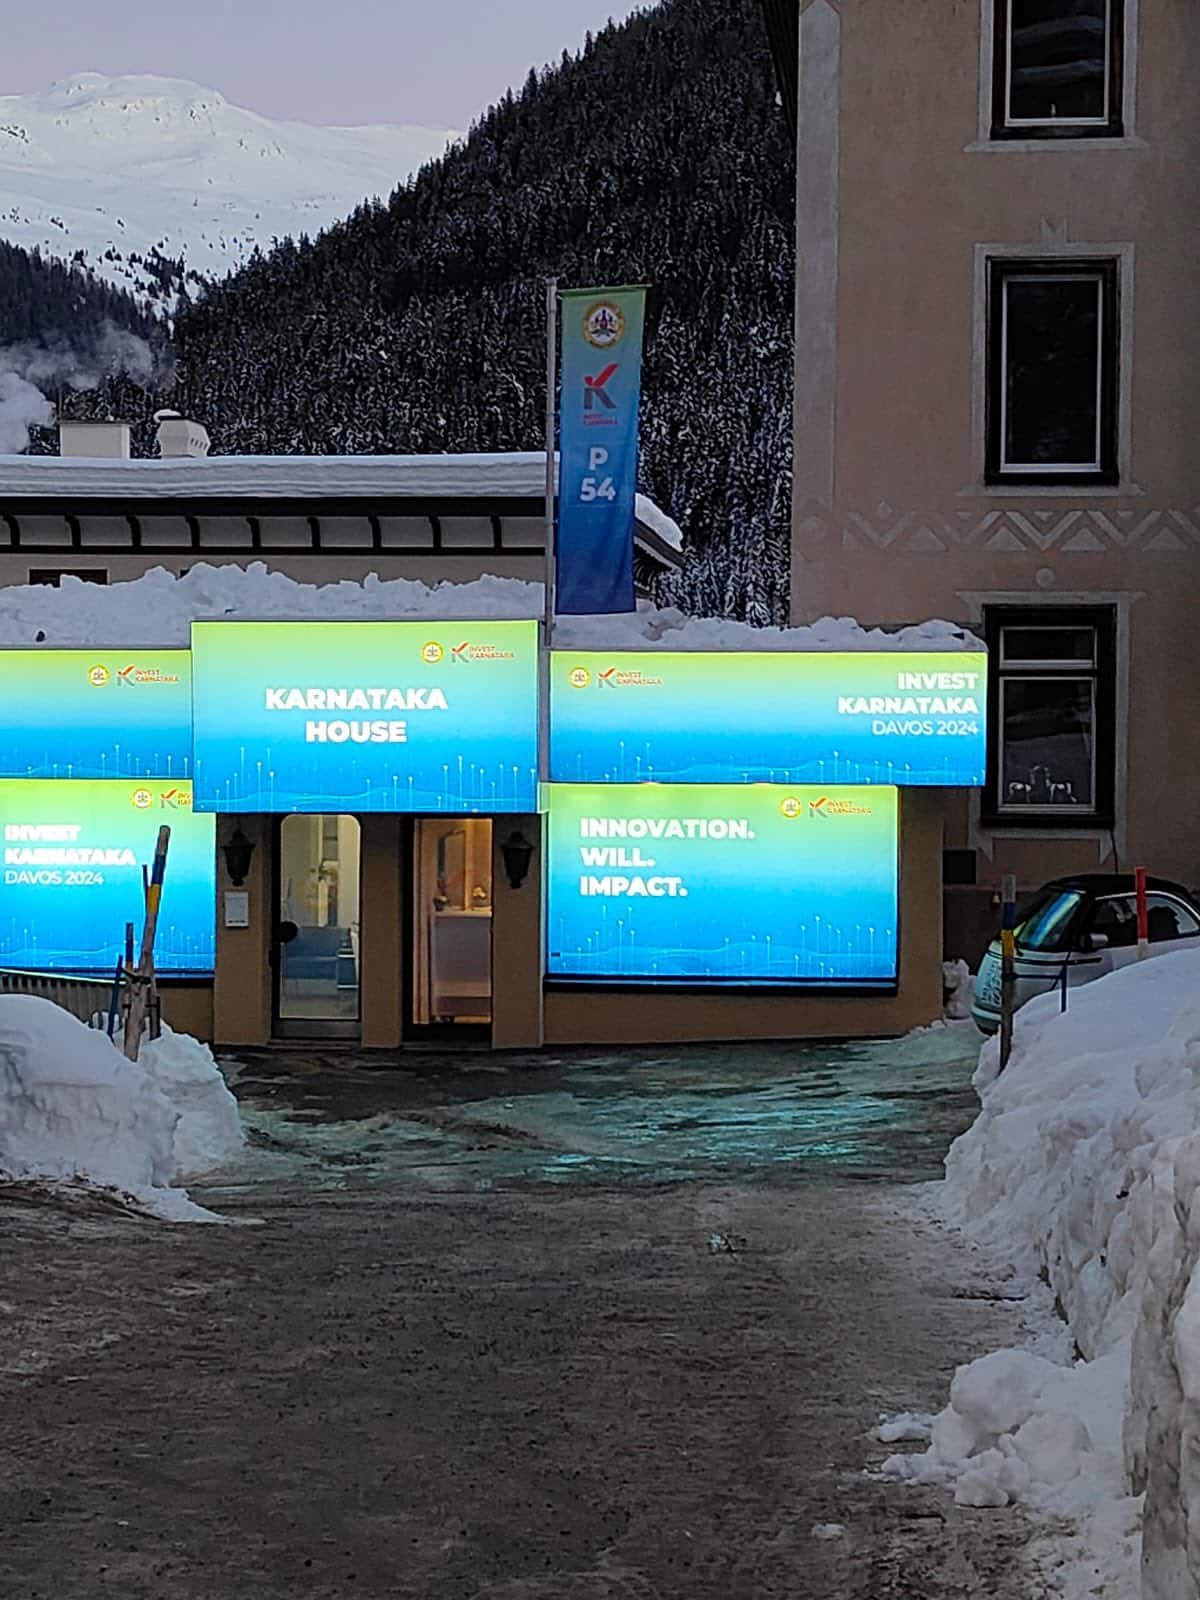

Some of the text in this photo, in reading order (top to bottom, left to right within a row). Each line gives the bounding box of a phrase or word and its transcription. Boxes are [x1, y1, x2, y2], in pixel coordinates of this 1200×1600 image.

[589, 447, 608, 471] P
[580, 477, 616, 502] 54
[898, 672, 978, 690] INVEST
[265, 688, 449, 710] KARNATAKA
[838, 697, 979, 714] KARNATAKA
[306, 721, 408, 743] HOUSE
[872, 720, 978, 735] DAVOS 2024
[4, 824, 81, 841] INVEST
[580, 818, 755, 839] INNOVATION.
[4, 847, 137, 866] KARNATAKA
[580, 848, 656, 867] WILL.
[5, 870, 104, 885] DAVOS 2024
[580, 876, 688, 897] IMPACT.
